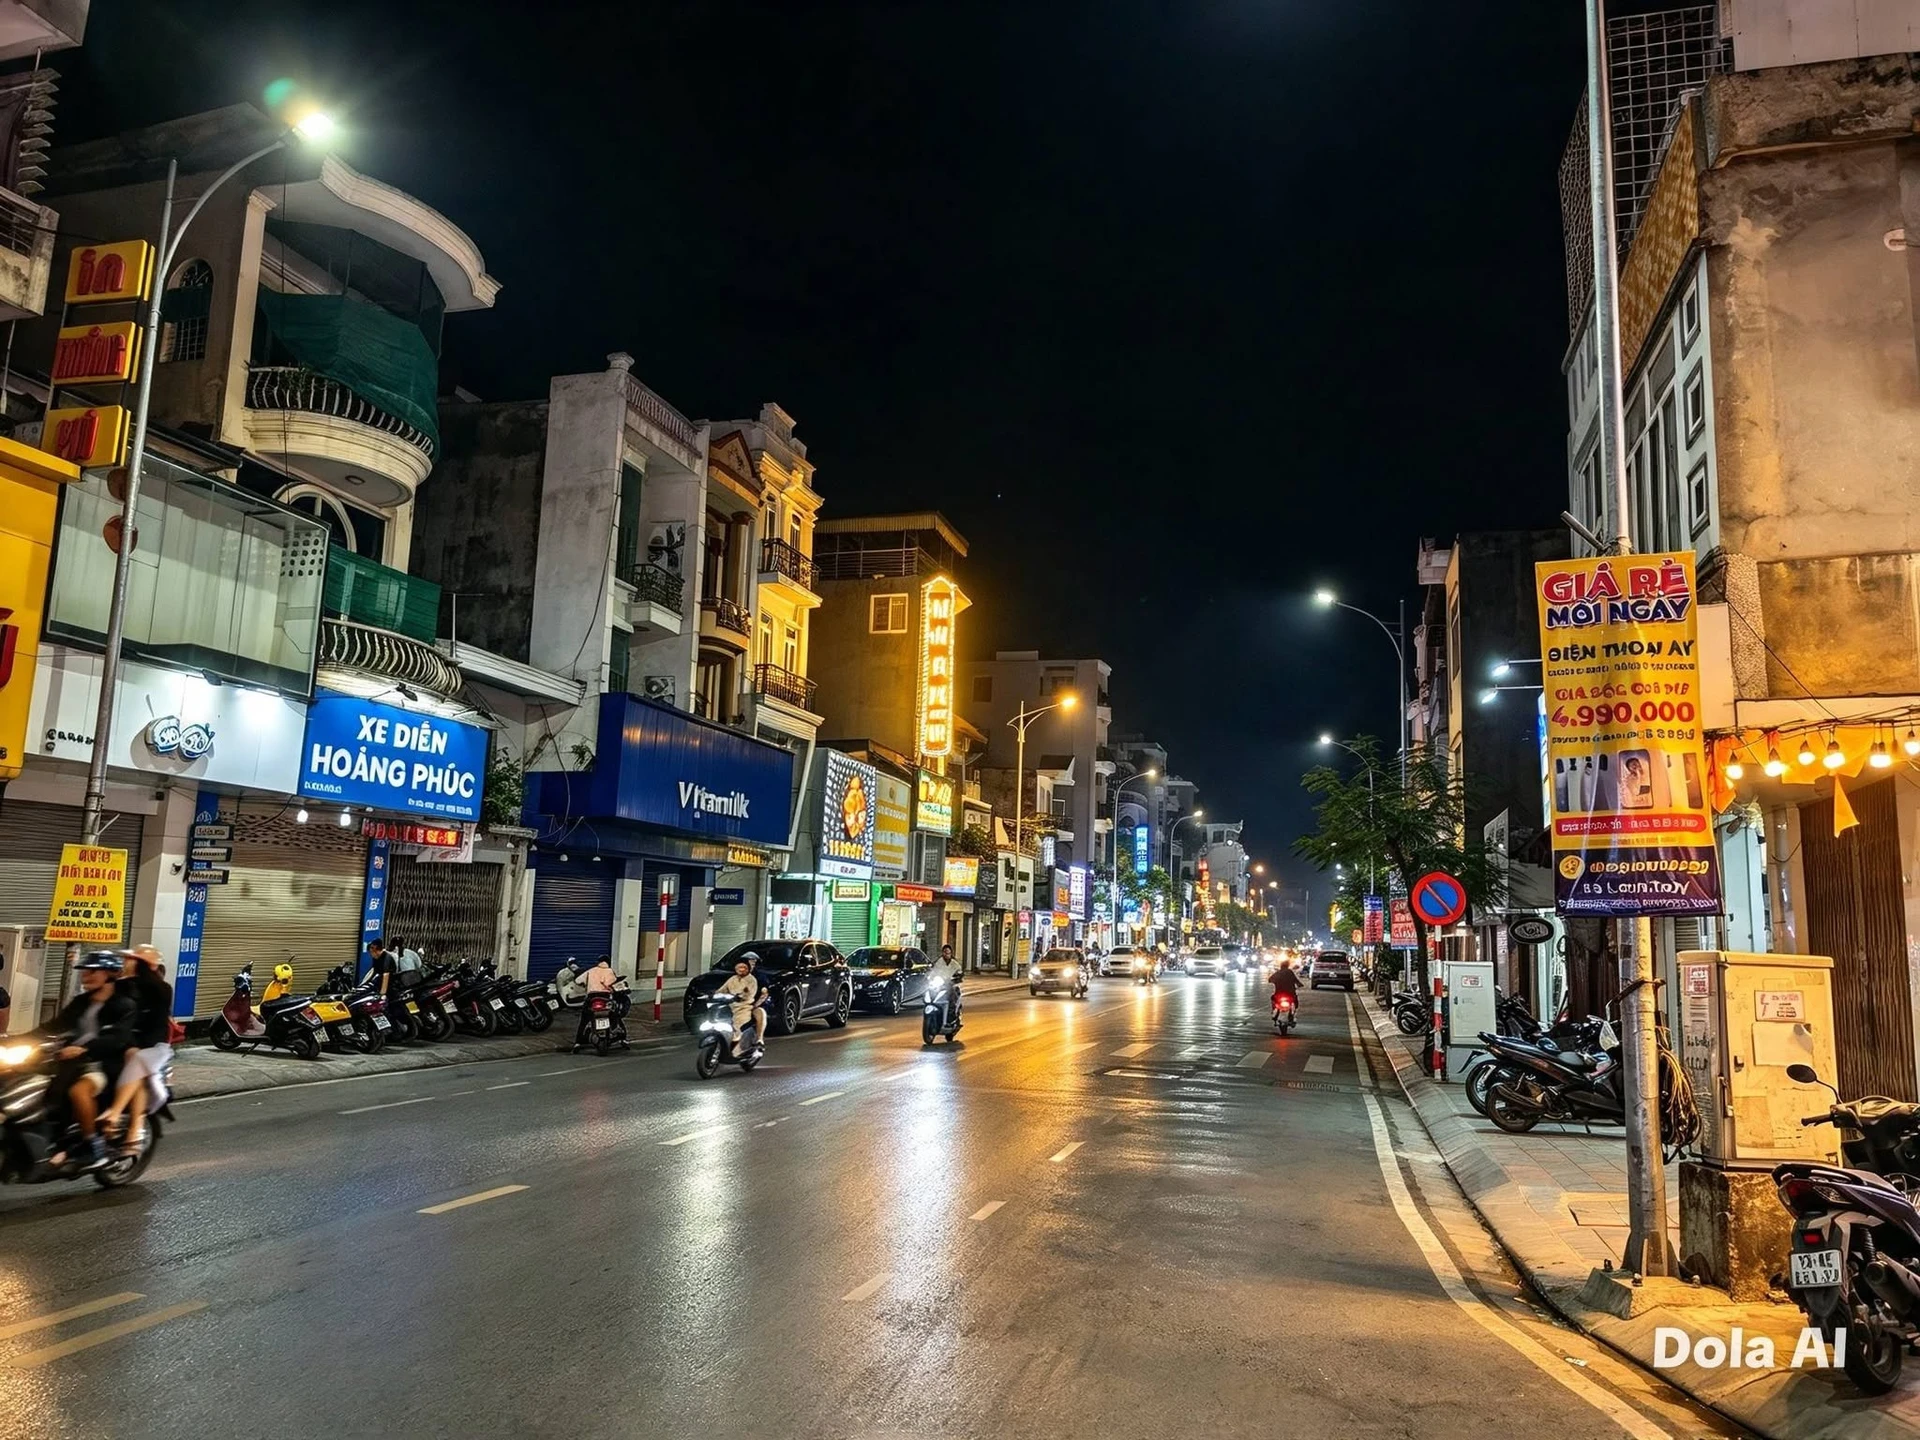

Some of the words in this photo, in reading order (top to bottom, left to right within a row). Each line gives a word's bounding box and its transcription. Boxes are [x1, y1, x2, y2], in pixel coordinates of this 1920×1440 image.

[357, 714, 390, 745] XE
[1551, 700, 1695, 728] 4.990.000
[411, 761, 476, 799] PHÚC
